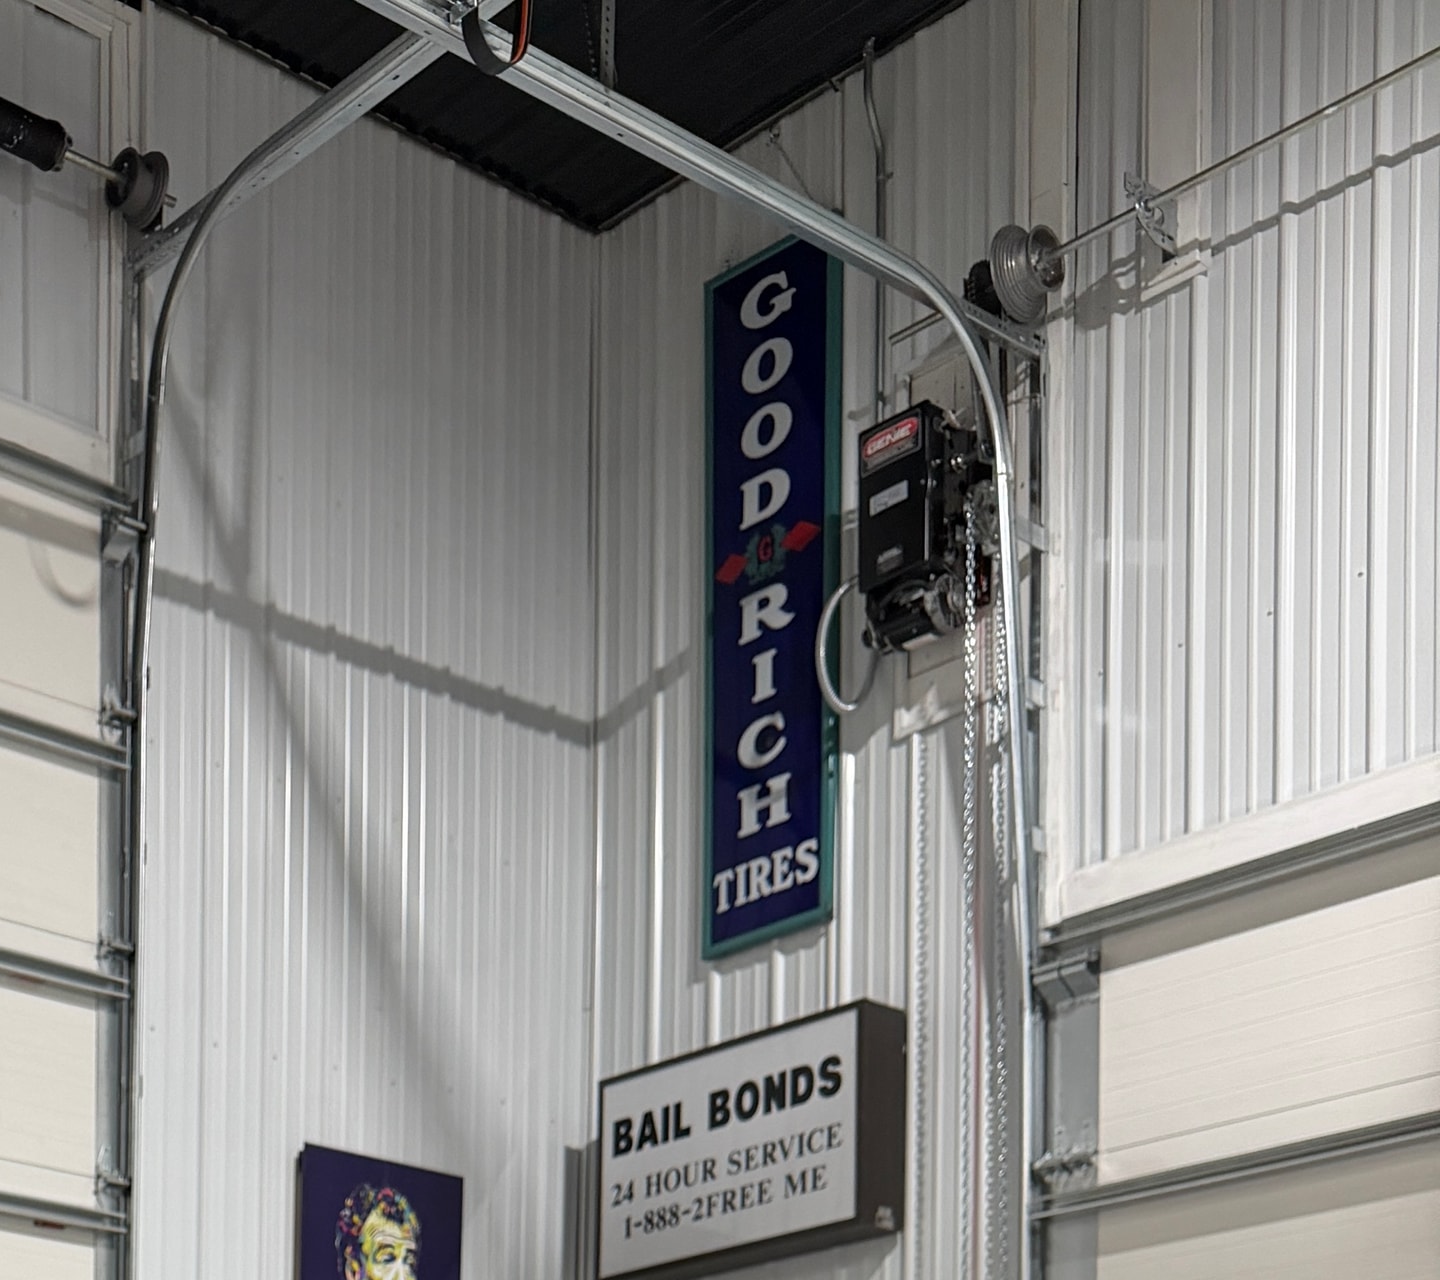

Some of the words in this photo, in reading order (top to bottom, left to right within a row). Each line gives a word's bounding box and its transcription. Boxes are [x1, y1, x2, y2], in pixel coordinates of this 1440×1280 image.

[713, 837, 820, 915] TIRES
[612, 1101, 692, 1158] BAIL
[708, 1054, 843, 1131] BONDS
[611, 1179, 635, 1208] 24
[645, 1158, 717, 1198] HOUR
[727, 1122, 844, 1176] SERVICE
[624, 1179, 774, 1240] 1-888-2FREE
[784, 1164, 828, 1200] ME
